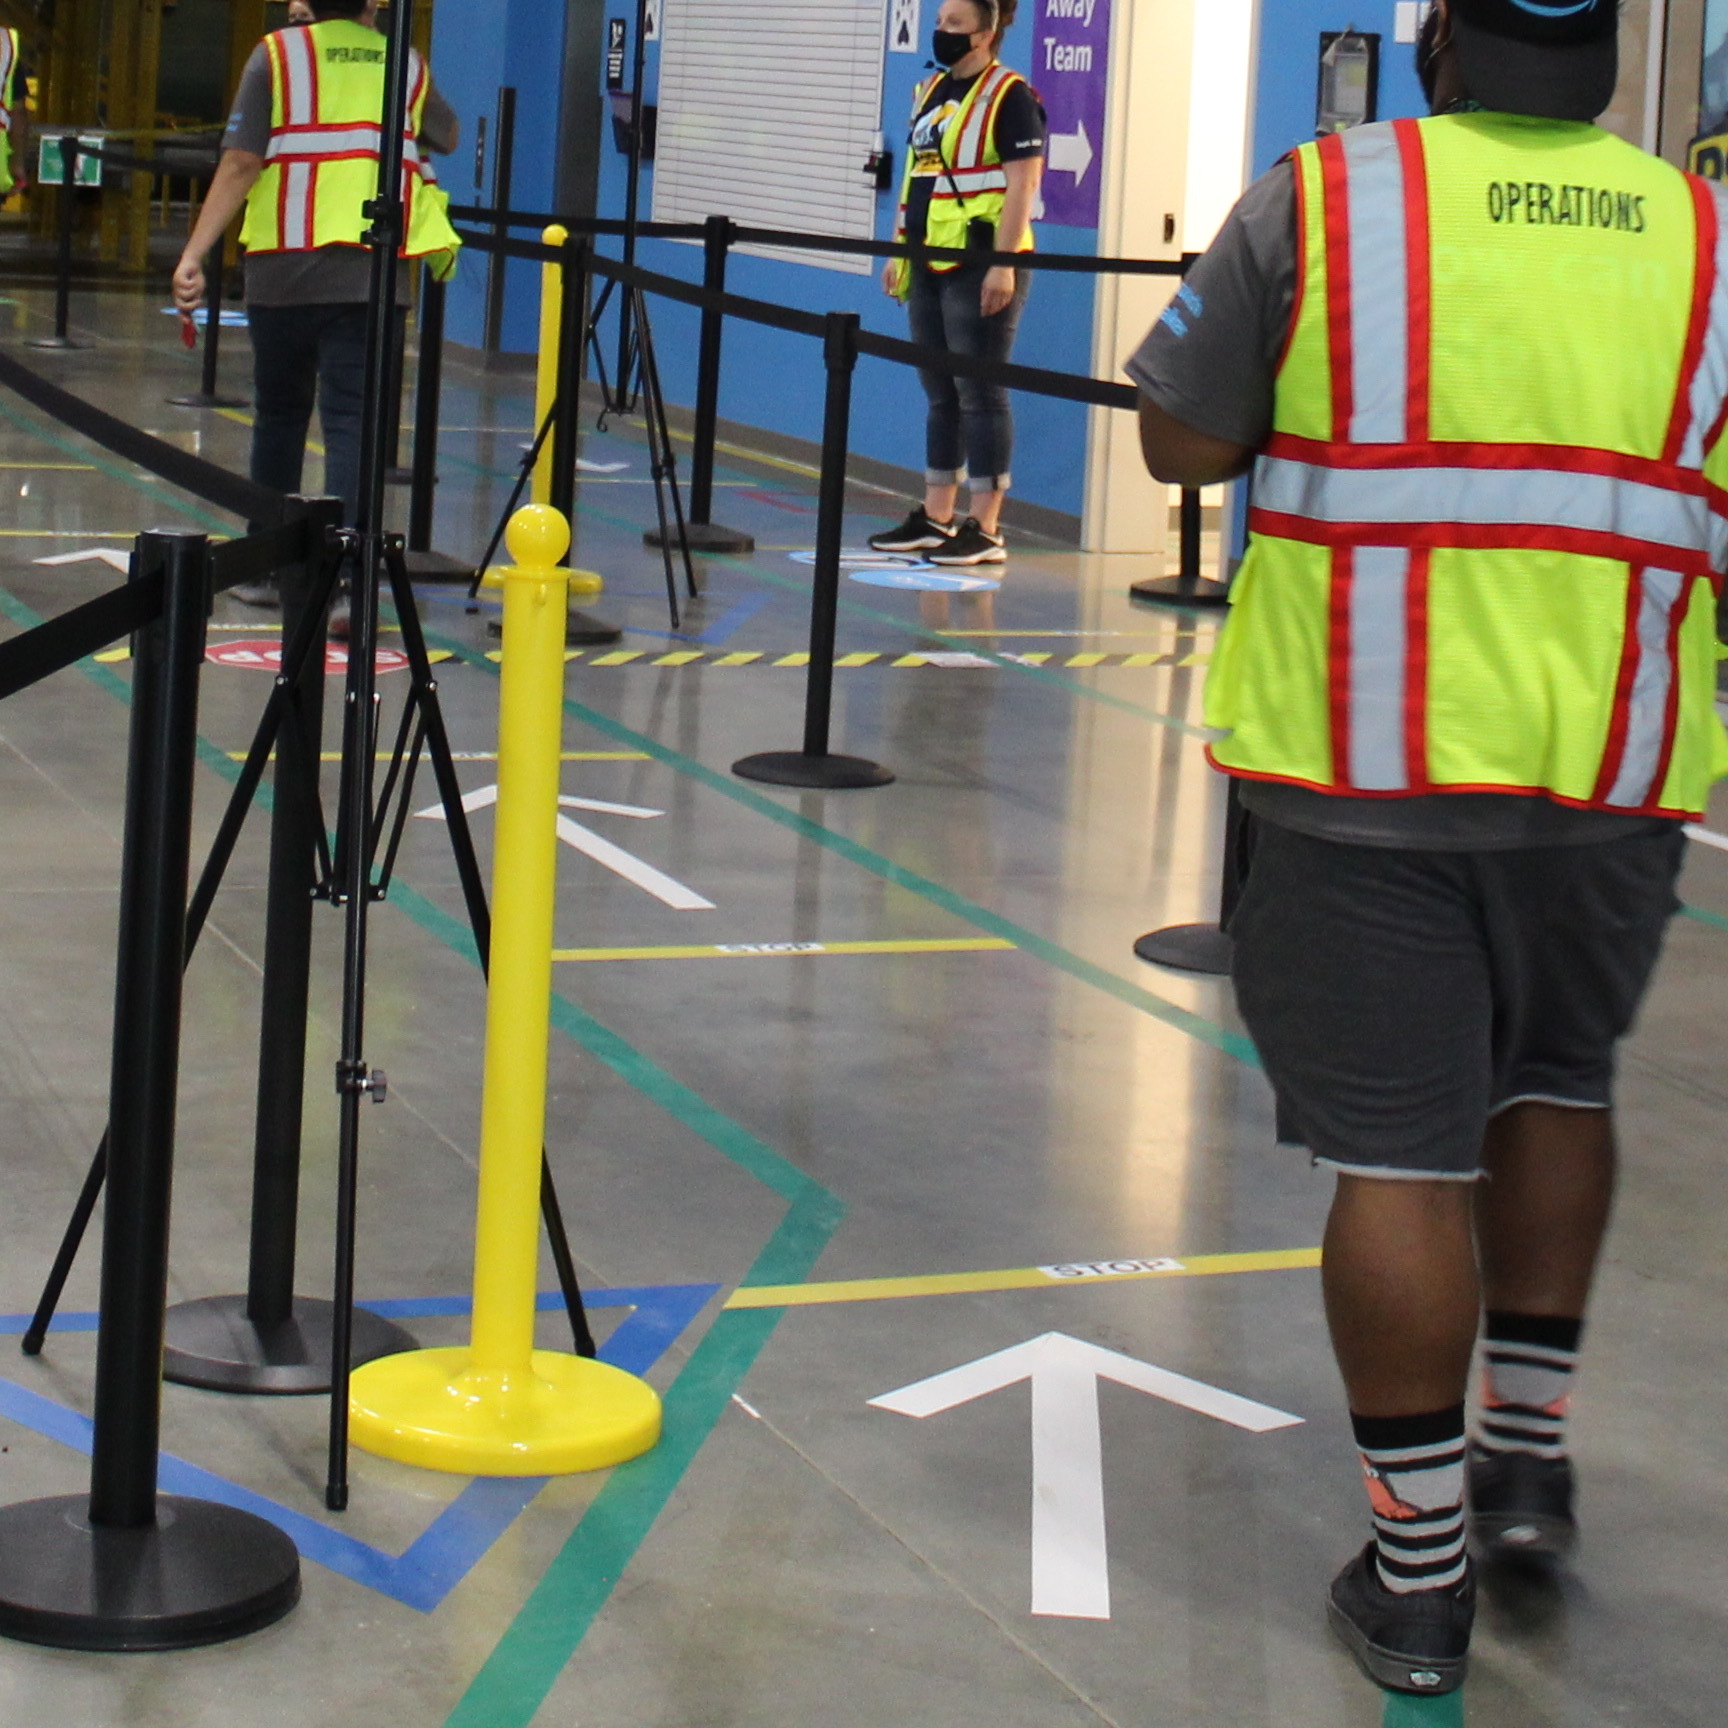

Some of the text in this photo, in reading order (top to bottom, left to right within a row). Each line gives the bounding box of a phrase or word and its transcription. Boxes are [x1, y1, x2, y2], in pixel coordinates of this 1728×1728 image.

[1043, 37, 1092, 71] Team
[1488, 181, 1646, 233] OPERATIONS
[1053, 1259, 1165, 1276] STOP
